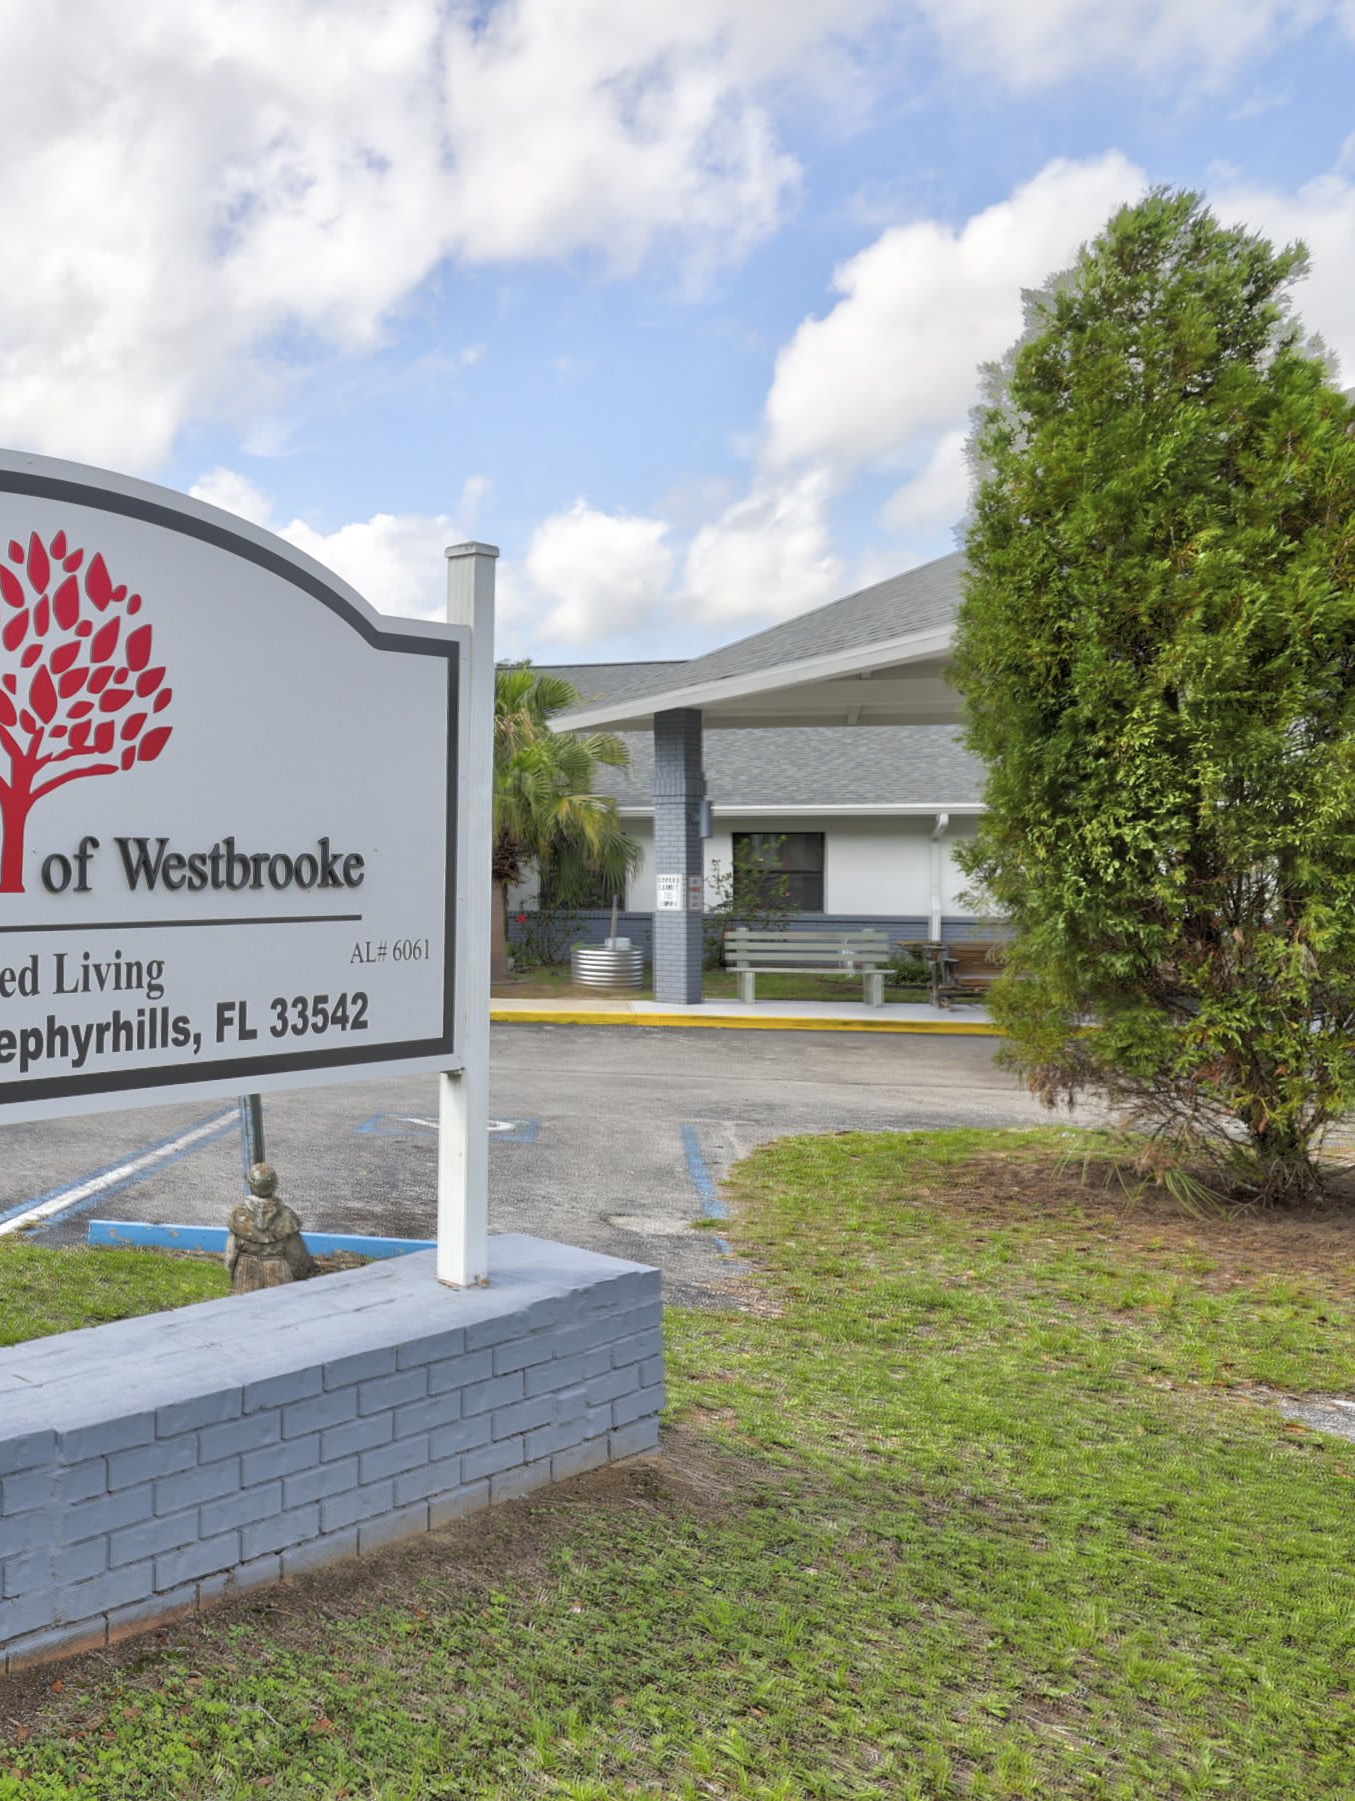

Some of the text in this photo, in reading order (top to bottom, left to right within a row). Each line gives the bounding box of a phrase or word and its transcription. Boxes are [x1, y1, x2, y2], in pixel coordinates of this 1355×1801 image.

[42, 836, 99, 894] of
[114, 836, 365, 893] Westbrooke
[53, 949, 165, 999] Living
[349, 938, 430, 964] AL# 6061
[217, 999, 258, 1043] FL
[269, 991, 369, 1038] 33542
